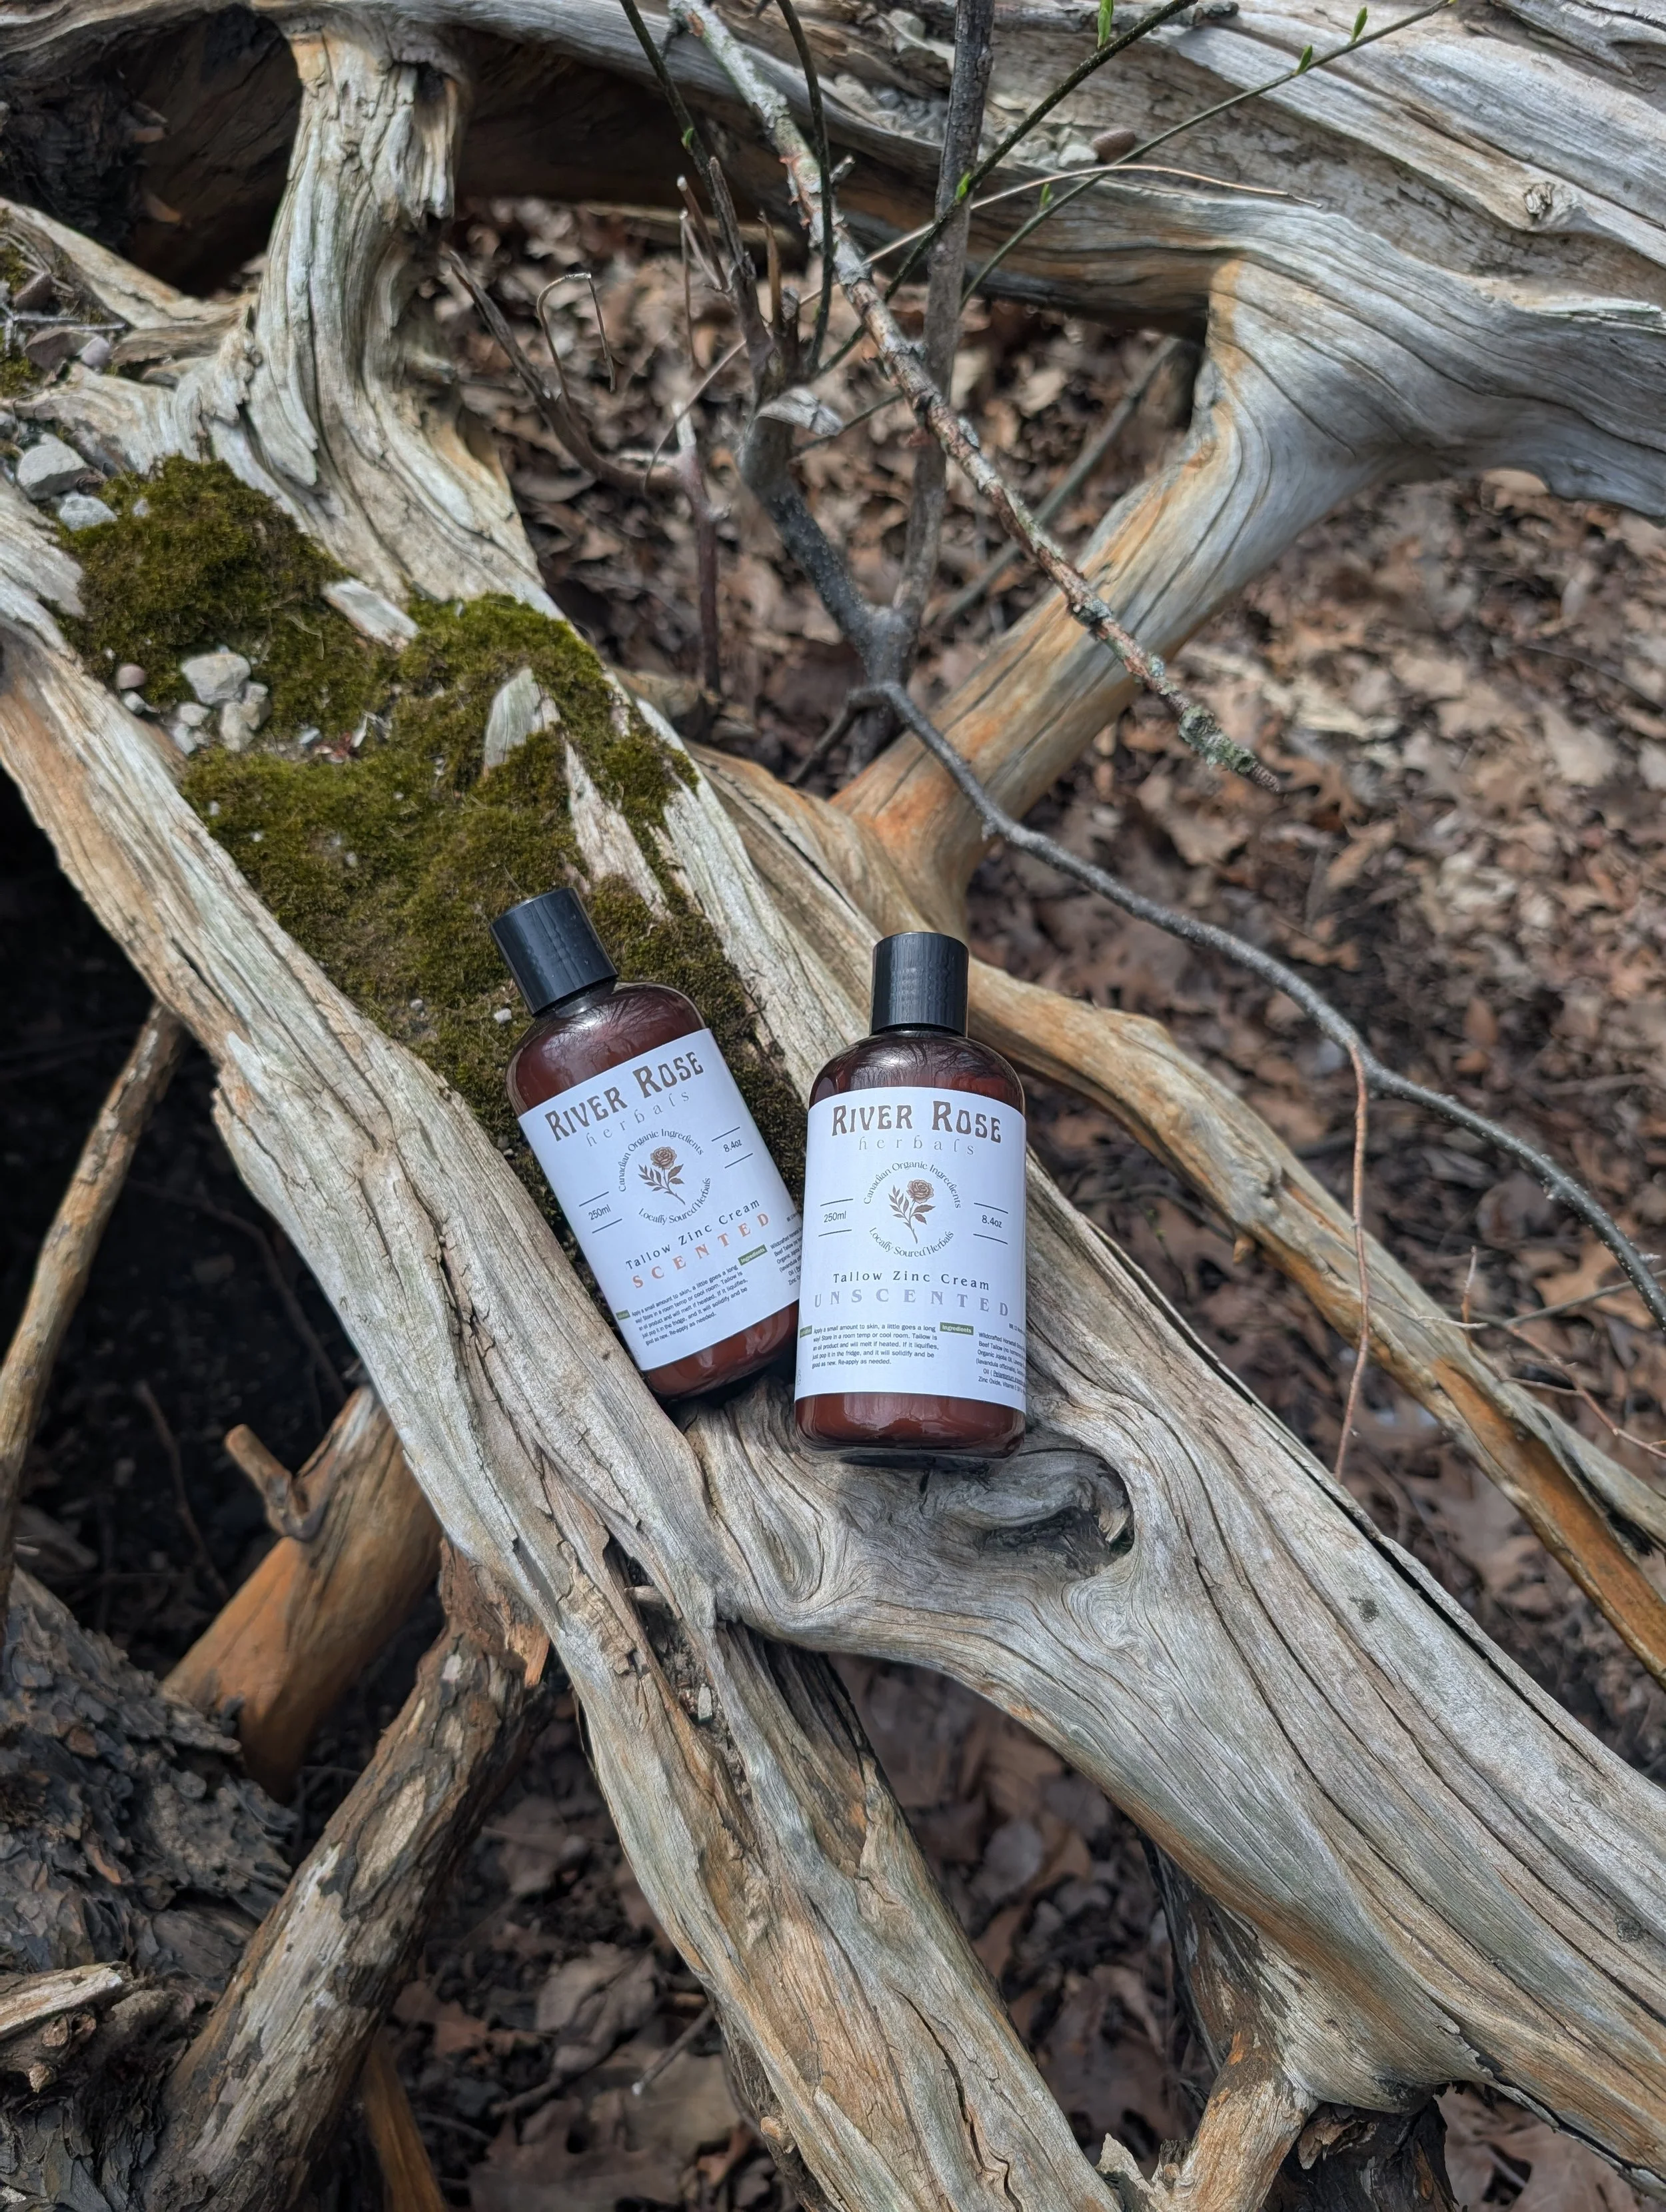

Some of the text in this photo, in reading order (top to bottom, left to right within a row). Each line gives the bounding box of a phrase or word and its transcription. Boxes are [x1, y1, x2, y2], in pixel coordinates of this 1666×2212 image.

[545, 1051, 704, 1141] RIVER ROSE
[586, 1091, 690, 1147] herbals
[832, 1101, 1002, 1143] RIVER ROSE
[723, 1139, 742, 1153] 8.4oz
[858, 1135, 974, 1155] herbals
[619, 1128, 704, 1192] Canadian Organic Ingredients
[864, 1161, 961, 1209] Canadian Organic Ingredients
[638, 1208, 667, 1225] Locally
[694, 1178, 710, 1208] Herbals
[588, 1205, 611, 1221] 250ml
[824, 1211, 846, 1223] 250ml
[982, 1215, 1002, 1228] 8.4oz
[626, 1243, 670, 1269] Tallow
[678, 1225, 712, 1246] Zinc
[719, 1199, 760, 1225] Cream
[770, 1235, 790, 1249] Wildcrafted
[870, 1227, 894, 1252] Locally
[926, 1231, 954, 1255] Herbals
[632, 1213, 769, 1289] SCENTED
[740, 1248, 765, 1263] Ingredients
[774, 1248, 783, 1257] Beef
[777, 1254, 791, 1264] Organic
[644, 1303, 655, 1312] small
[656, 1297, 672, 1307] amount
[709, 1274, 721, 1283] goes
[726, 1265, 738, 1273] long
[694, 1289, 704, 1298] cool
[706, 1284, 720, 1293] room.
[720, 1275, 736, 1284] Tallow
[834, 1271, 990, 1290] Tallow Zinc Cream
[648, 1319, 663, 1328] product
[697, 1294, 716, 1306] heated.
[726, 1279, 748, 1291] liquifies,
[712, 1297, 730, 1307] solidify
[814, 1289, 1008, 1317] UNSCENTED
[669, 1325, 688, 1335] Re-apply
[696, 1311, 716, 1324] needed.
[942, 1325, 972, 1333] Ingredients
[978, 1332, 1002, 1343] Wildcrafted
[990, 1343, 1002, 1351] Tallow
[976, 1358, 998, 1367] (lavandula
[978, 1349, 994, 1358] Organic
